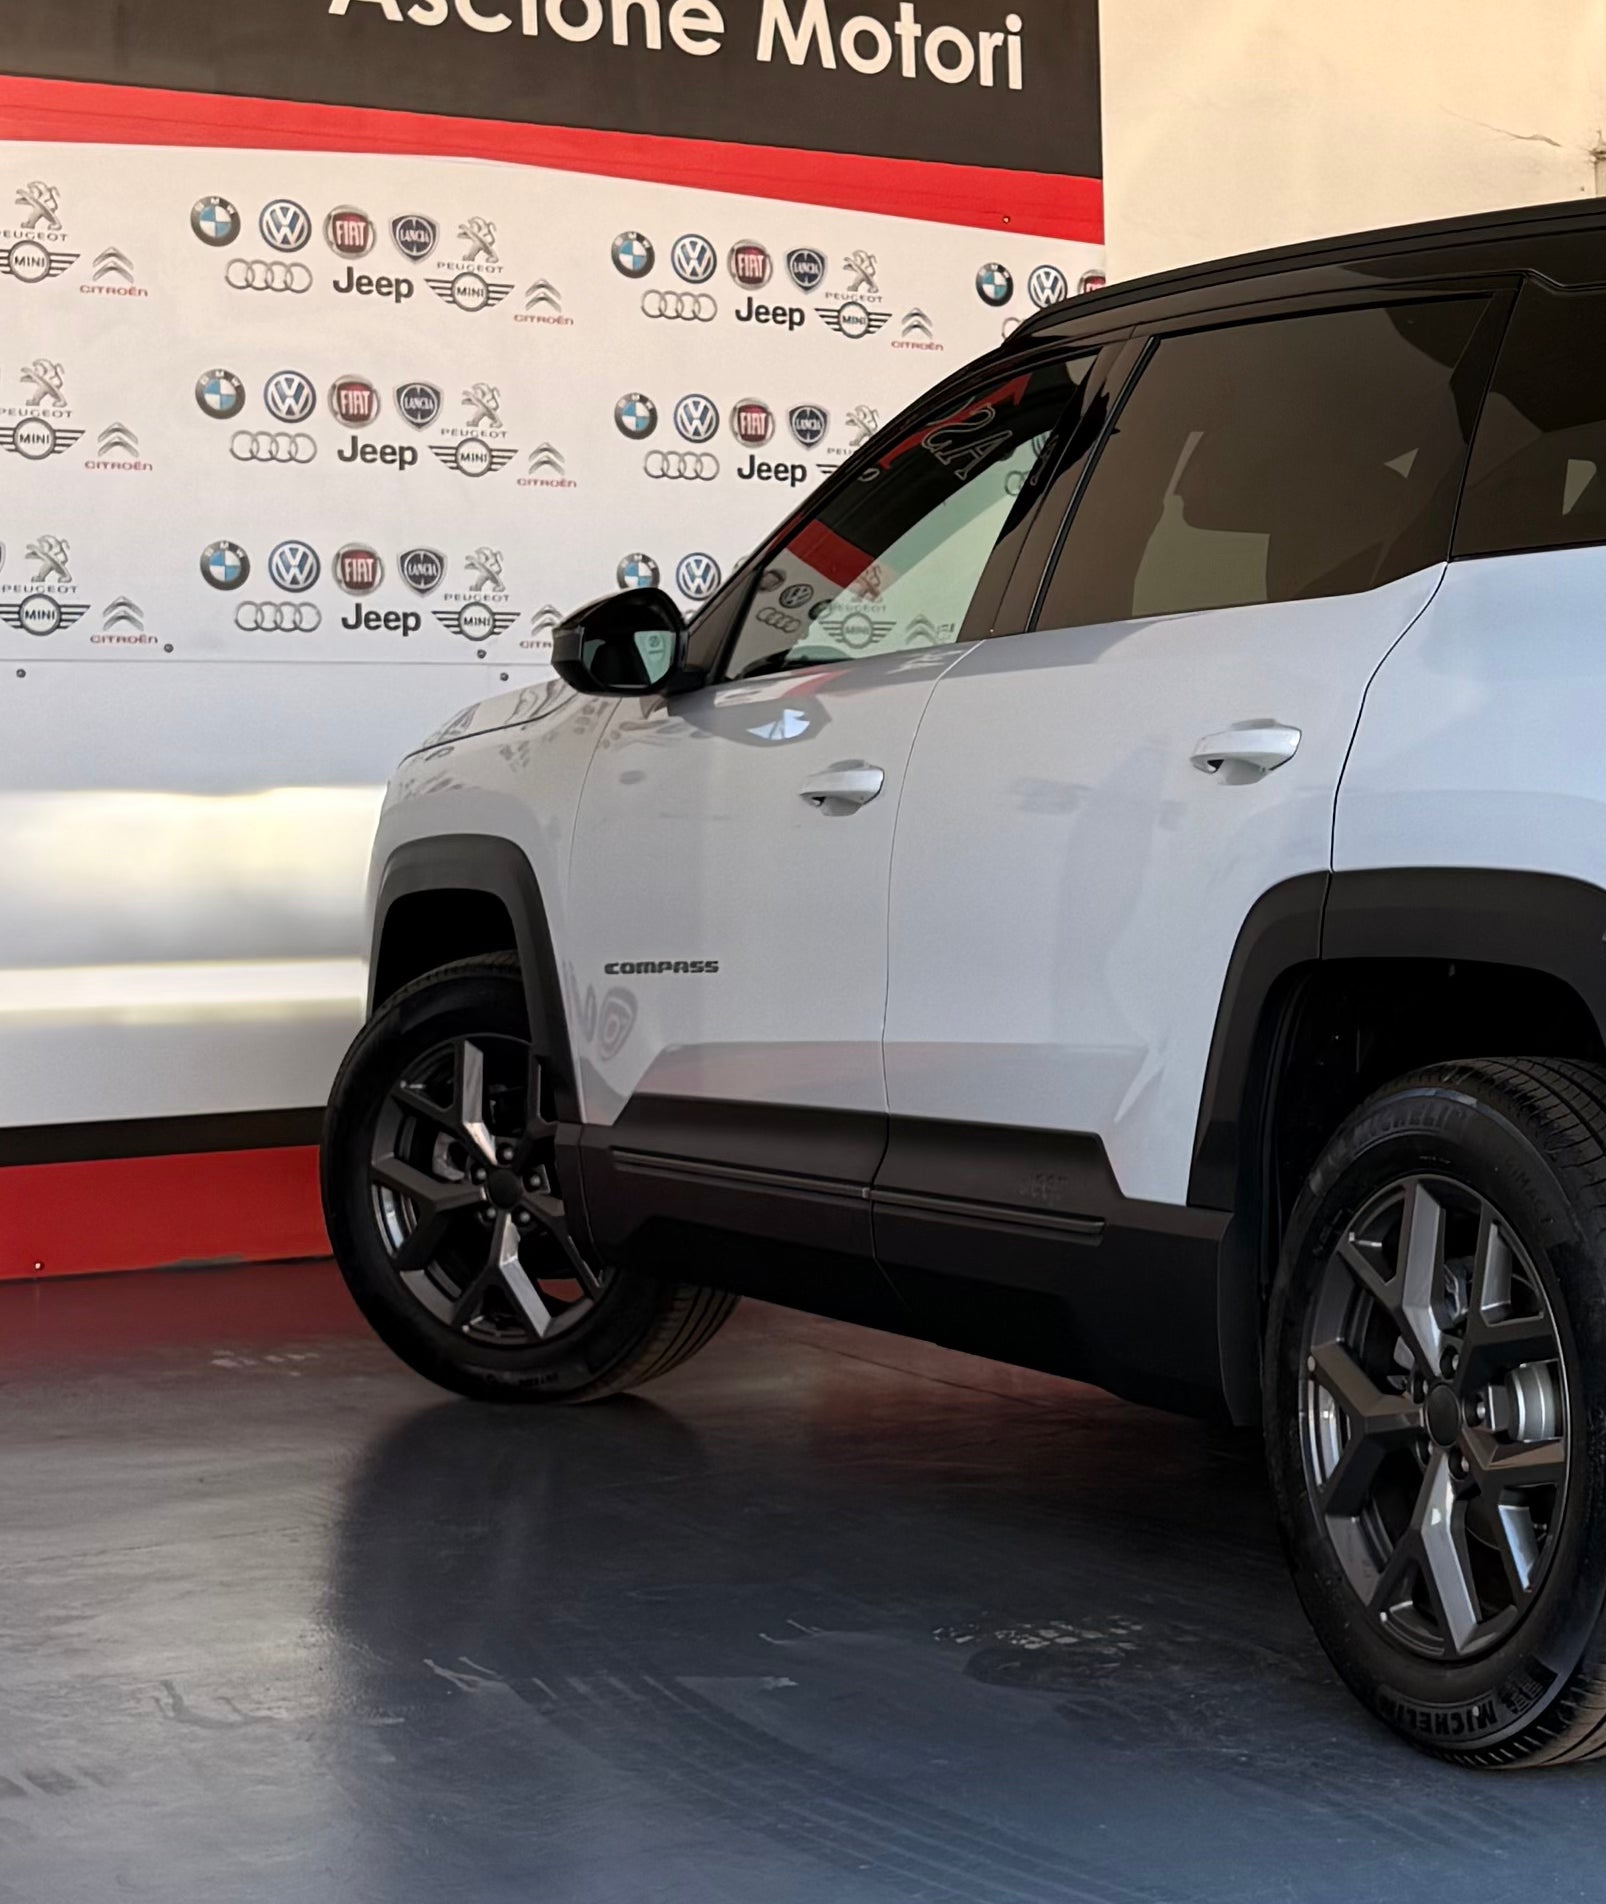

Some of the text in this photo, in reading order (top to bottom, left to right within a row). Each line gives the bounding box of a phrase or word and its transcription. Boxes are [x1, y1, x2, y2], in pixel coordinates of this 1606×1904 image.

[0, 230, 68, 242] EUGEOT
[335, 220, 367, 246] FIAT
[14, 255, 45, 268] MINI
[436, 261, 504, 273] PEUGEOT
[737, 253, 765, 278] FIAT
[333, 266, 414, 303] Jeep
[456, 285, 485, 298] MINI
[824, 291, 883, 303] PEUGEOT
[735, 296, 806, 331] Jeep
[340, 389, 371, 415] FIAT
[739, 411, 767, 436] FIAT
[19, 433, 50, 445] MINI
[440, 428, 508, 439] PEUGEOT
[337, 435, 418, 471] Jeep
[460, 452, 488, 463] MINI
[737, 454, 808, 487] Jeep
[344, 558, 375, 582] FIAT
[2, 584, 78, 594] PEUGEOT
[443, 593, 510, 602] PEUGEOT
[24, 609, 55, 621] MINI
[341, 603, 422, 637] Jeep
[463, 616, 491, 627] MINI
[604, 960, 720, 975] COMPASS
